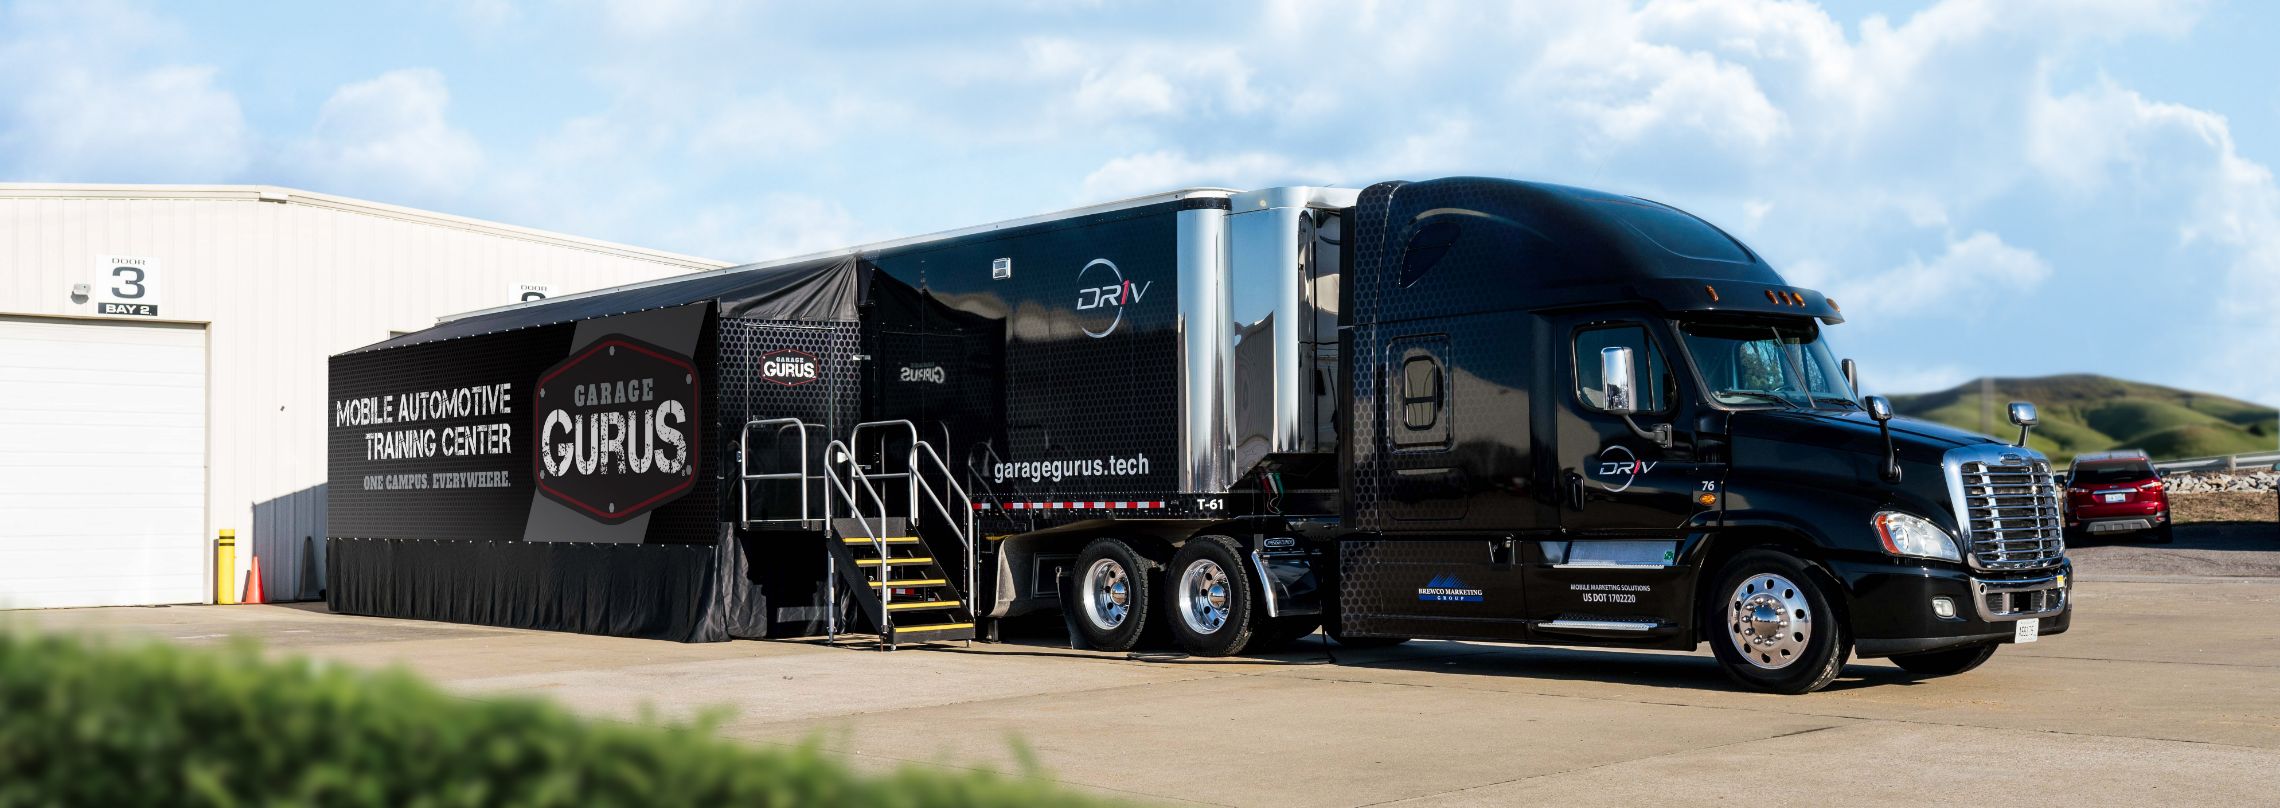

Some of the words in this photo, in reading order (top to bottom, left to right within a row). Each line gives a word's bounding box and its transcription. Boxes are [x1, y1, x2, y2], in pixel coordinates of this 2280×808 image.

[112, 266, 145, 299] 3
[105, 303, 137, 314] BAY
[139, 305, 151, 315] 2
[763, 361, 815, 378] GURUS
[574, 378, 654, 407] GARAGE
[336, 395, 393, 427] MOBILE
[398, 383, 511, 423] AUTOMOTIVE
[365, 428, 437, 460] TRAINING
[441, 423, 512, 457] CENTER
[541, 399, 687, 477] GURUS
[994, 452, 1149, 484] garagegurus.tech
[363, 475, 384, 490] ONE
[385, 473, 430, 490] CAMPUS.
[432, 470, 511, 489] EVERYWHERE.
[1702, 480, 1715, 491] 76
[1196, 498, 1224, 510] T-61
[1445, 588, 1483, 596] MARKETING
[1570, 583, 1590, 591] MOBILE
[1621, 584, 1651, 592] SOLUTIONS
[1582, 593, 1592, 602] US
[1593, 593, 1607, 602] DOT
[1608, 594, 1636, 603] 1702220
